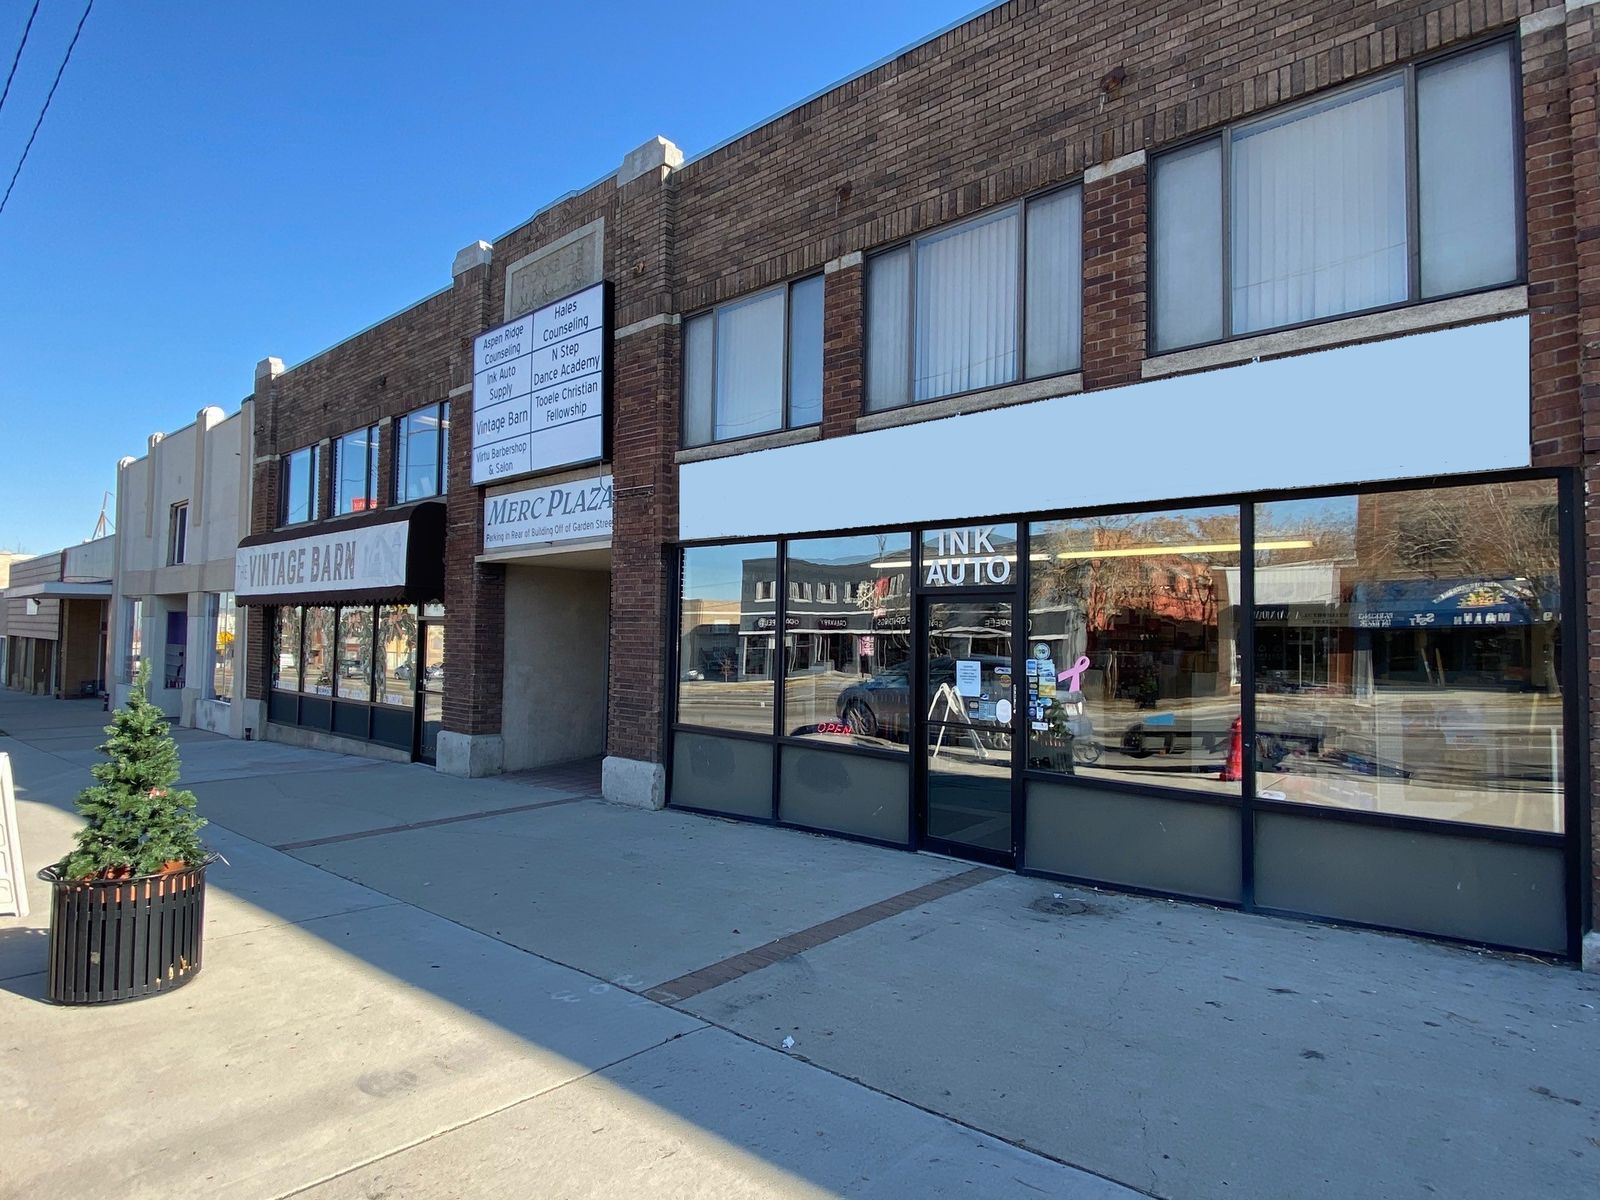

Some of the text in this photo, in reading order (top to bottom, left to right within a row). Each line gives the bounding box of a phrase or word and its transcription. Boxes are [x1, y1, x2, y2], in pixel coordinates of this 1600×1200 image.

[554, 301, 577, 319] Hales
[483, 324, 524, 350] Aspen Ridge
[543, 315, 589, 342] Counseling
[484, 343, 521, 365] Counseling
[551, 342, 579, 361] N Step
[486, 366, 516, 385] Ink Auto
[534, 355, 600, 386] Dance Academy
[489, 383, 512, 401] Supply
[535, 381, 598, 408] Tooele Christian
[476, 410, 528, 435] Vintage Barn
[546, 401, 587, 422] Fellowship
[476, 441, 527, 463] Virtu Barbershop
[488, 461, 514, 475] & Salon
[486, 519, 613, 542] Parking in Rear of Building Off of Garden Stree
[938, 526, 996, 556] INK
[249, 548, 306, 587] VINTAGE
[310, 541, 357, 583] BARN
[925, 555, 1011, 585] AUTO
[817, 722, 852, 734] OPEN
